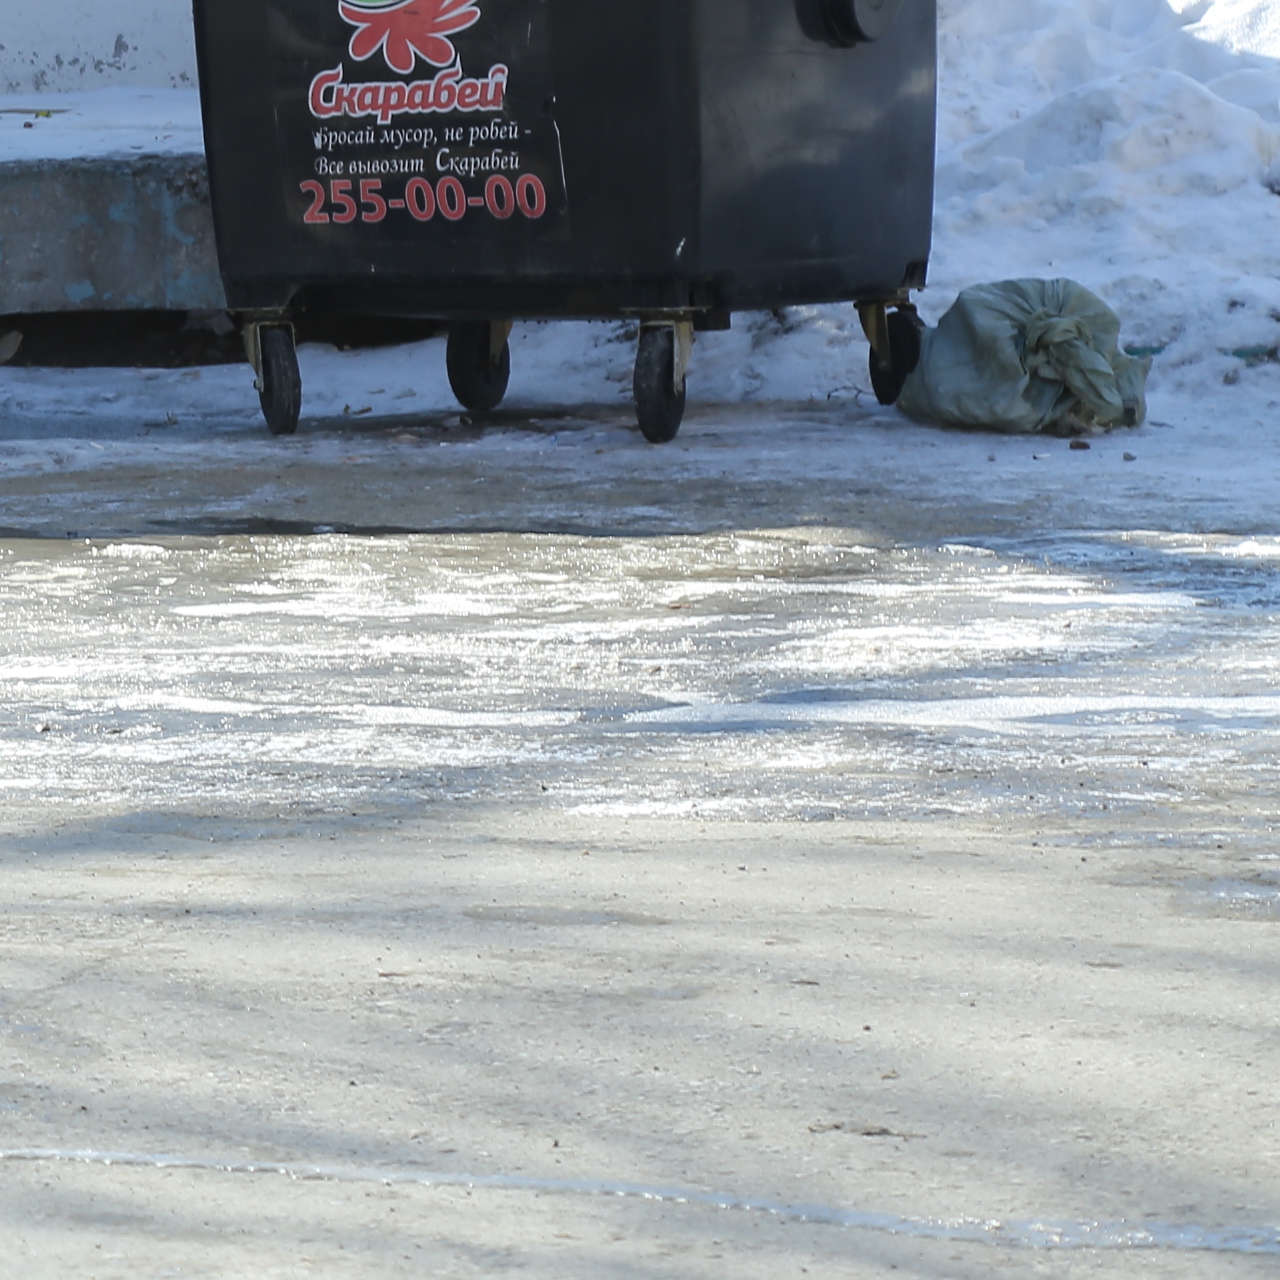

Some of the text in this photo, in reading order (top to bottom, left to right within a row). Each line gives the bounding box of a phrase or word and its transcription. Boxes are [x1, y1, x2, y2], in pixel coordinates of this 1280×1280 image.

[308, 52, 509, 125] Скарабей
[380, 128, 438, 150] мусор,
[445, 127, 464, 141] не
[469, 119, 519, 147] робей
[315, 147, 520, 177] Все вывозит Скарабей
[300, 173, 546, 224] 255-00-00
